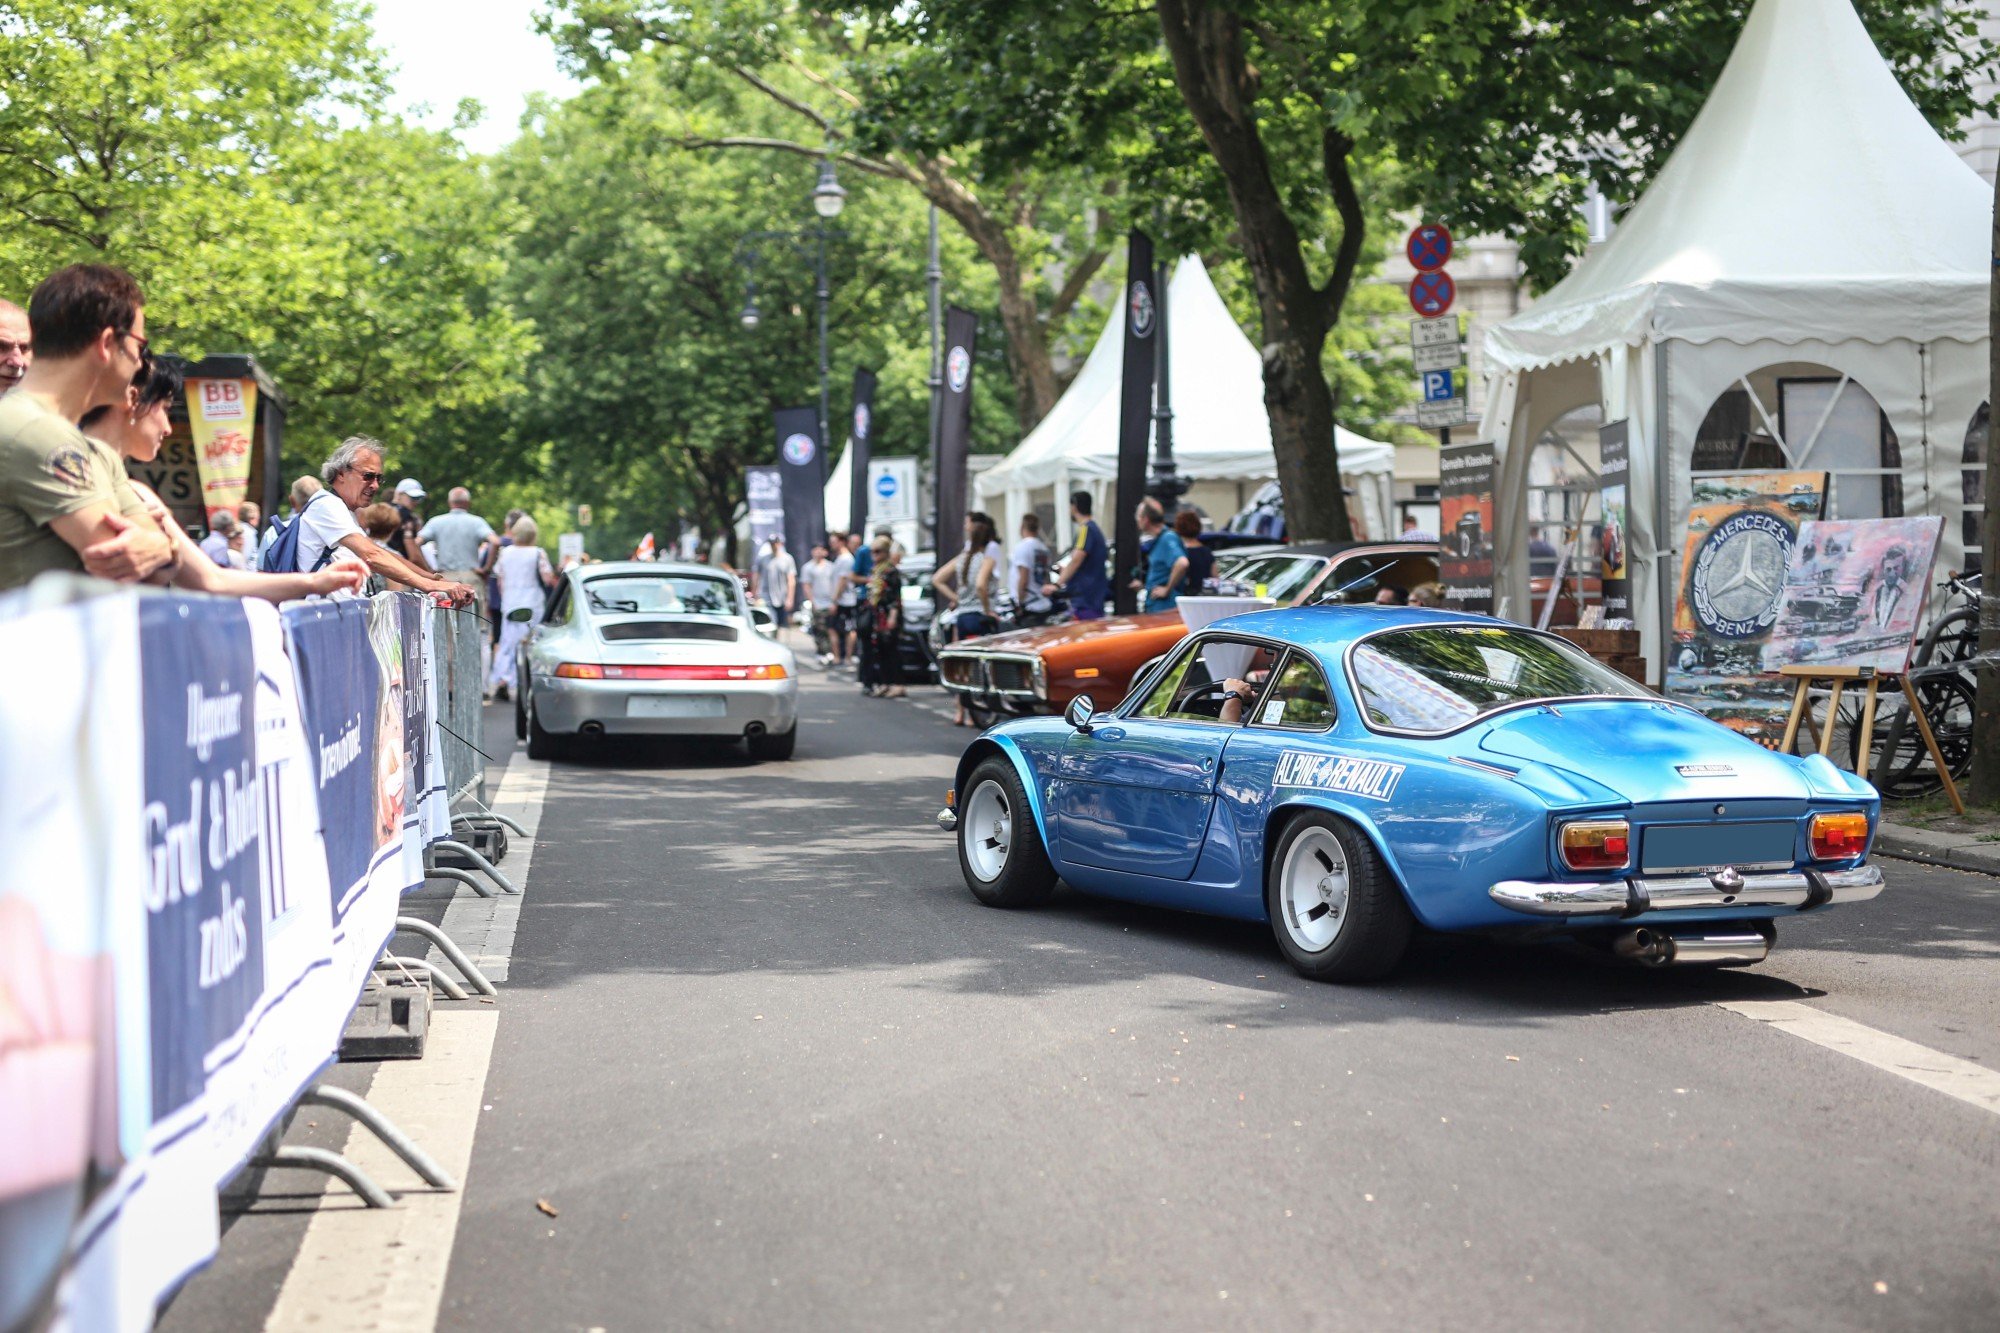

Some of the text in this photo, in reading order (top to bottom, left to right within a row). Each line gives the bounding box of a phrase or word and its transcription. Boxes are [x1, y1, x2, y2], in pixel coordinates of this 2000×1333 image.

[205, 383, 239, 402] BB
[1427, 374, 1444, 399] P
[1714, 514, 1788, 545] MERCEDES
[1715, 619, 1755, 636] BENZ
[1274, 753, 1400, 797] ALPINE RENAULT
